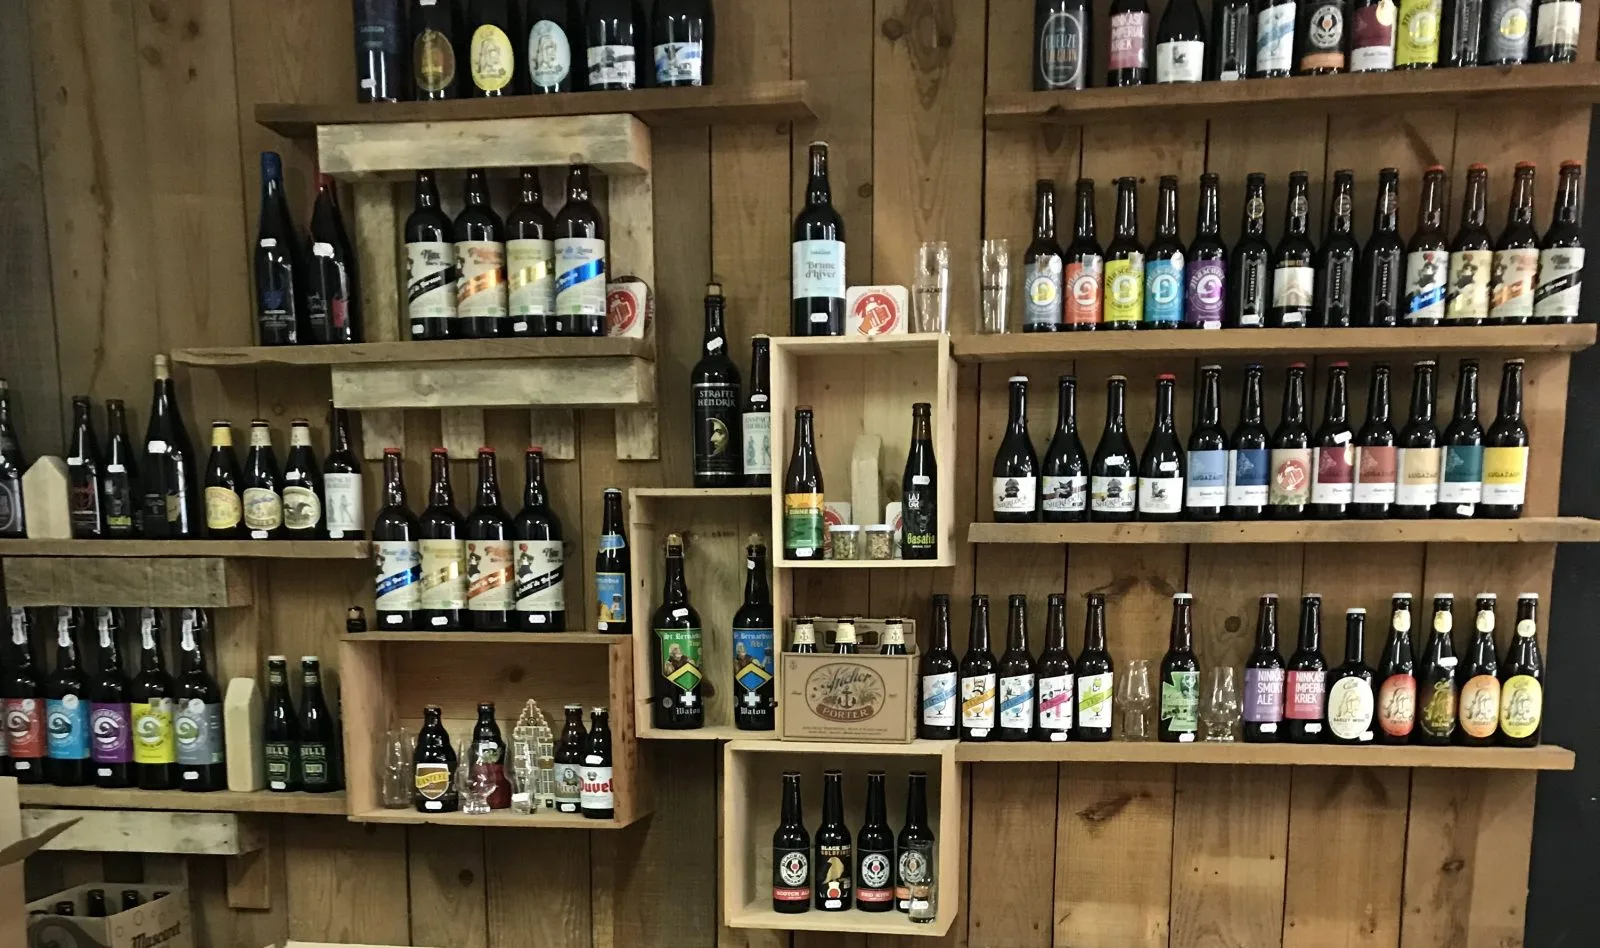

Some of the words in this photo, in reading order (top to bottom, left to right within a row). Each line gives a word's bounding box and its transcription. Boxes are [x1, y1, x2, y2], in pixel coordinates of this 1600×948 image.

[806, 261, 836, 269] Brune
[805, 269, 837, 280] d'hiver
[699, 390, 735, 398] STRAFFE
[698, 399, 736, 407] HENDRIK
[1257, 694, 1273, 704] ALE
[1294, 694, 1317, 703] KRIEK
[822, 707, 868, 719] PORTER
[301, 747, 325, 756] SILLY
[578, 776, 614, 793] Duvel
